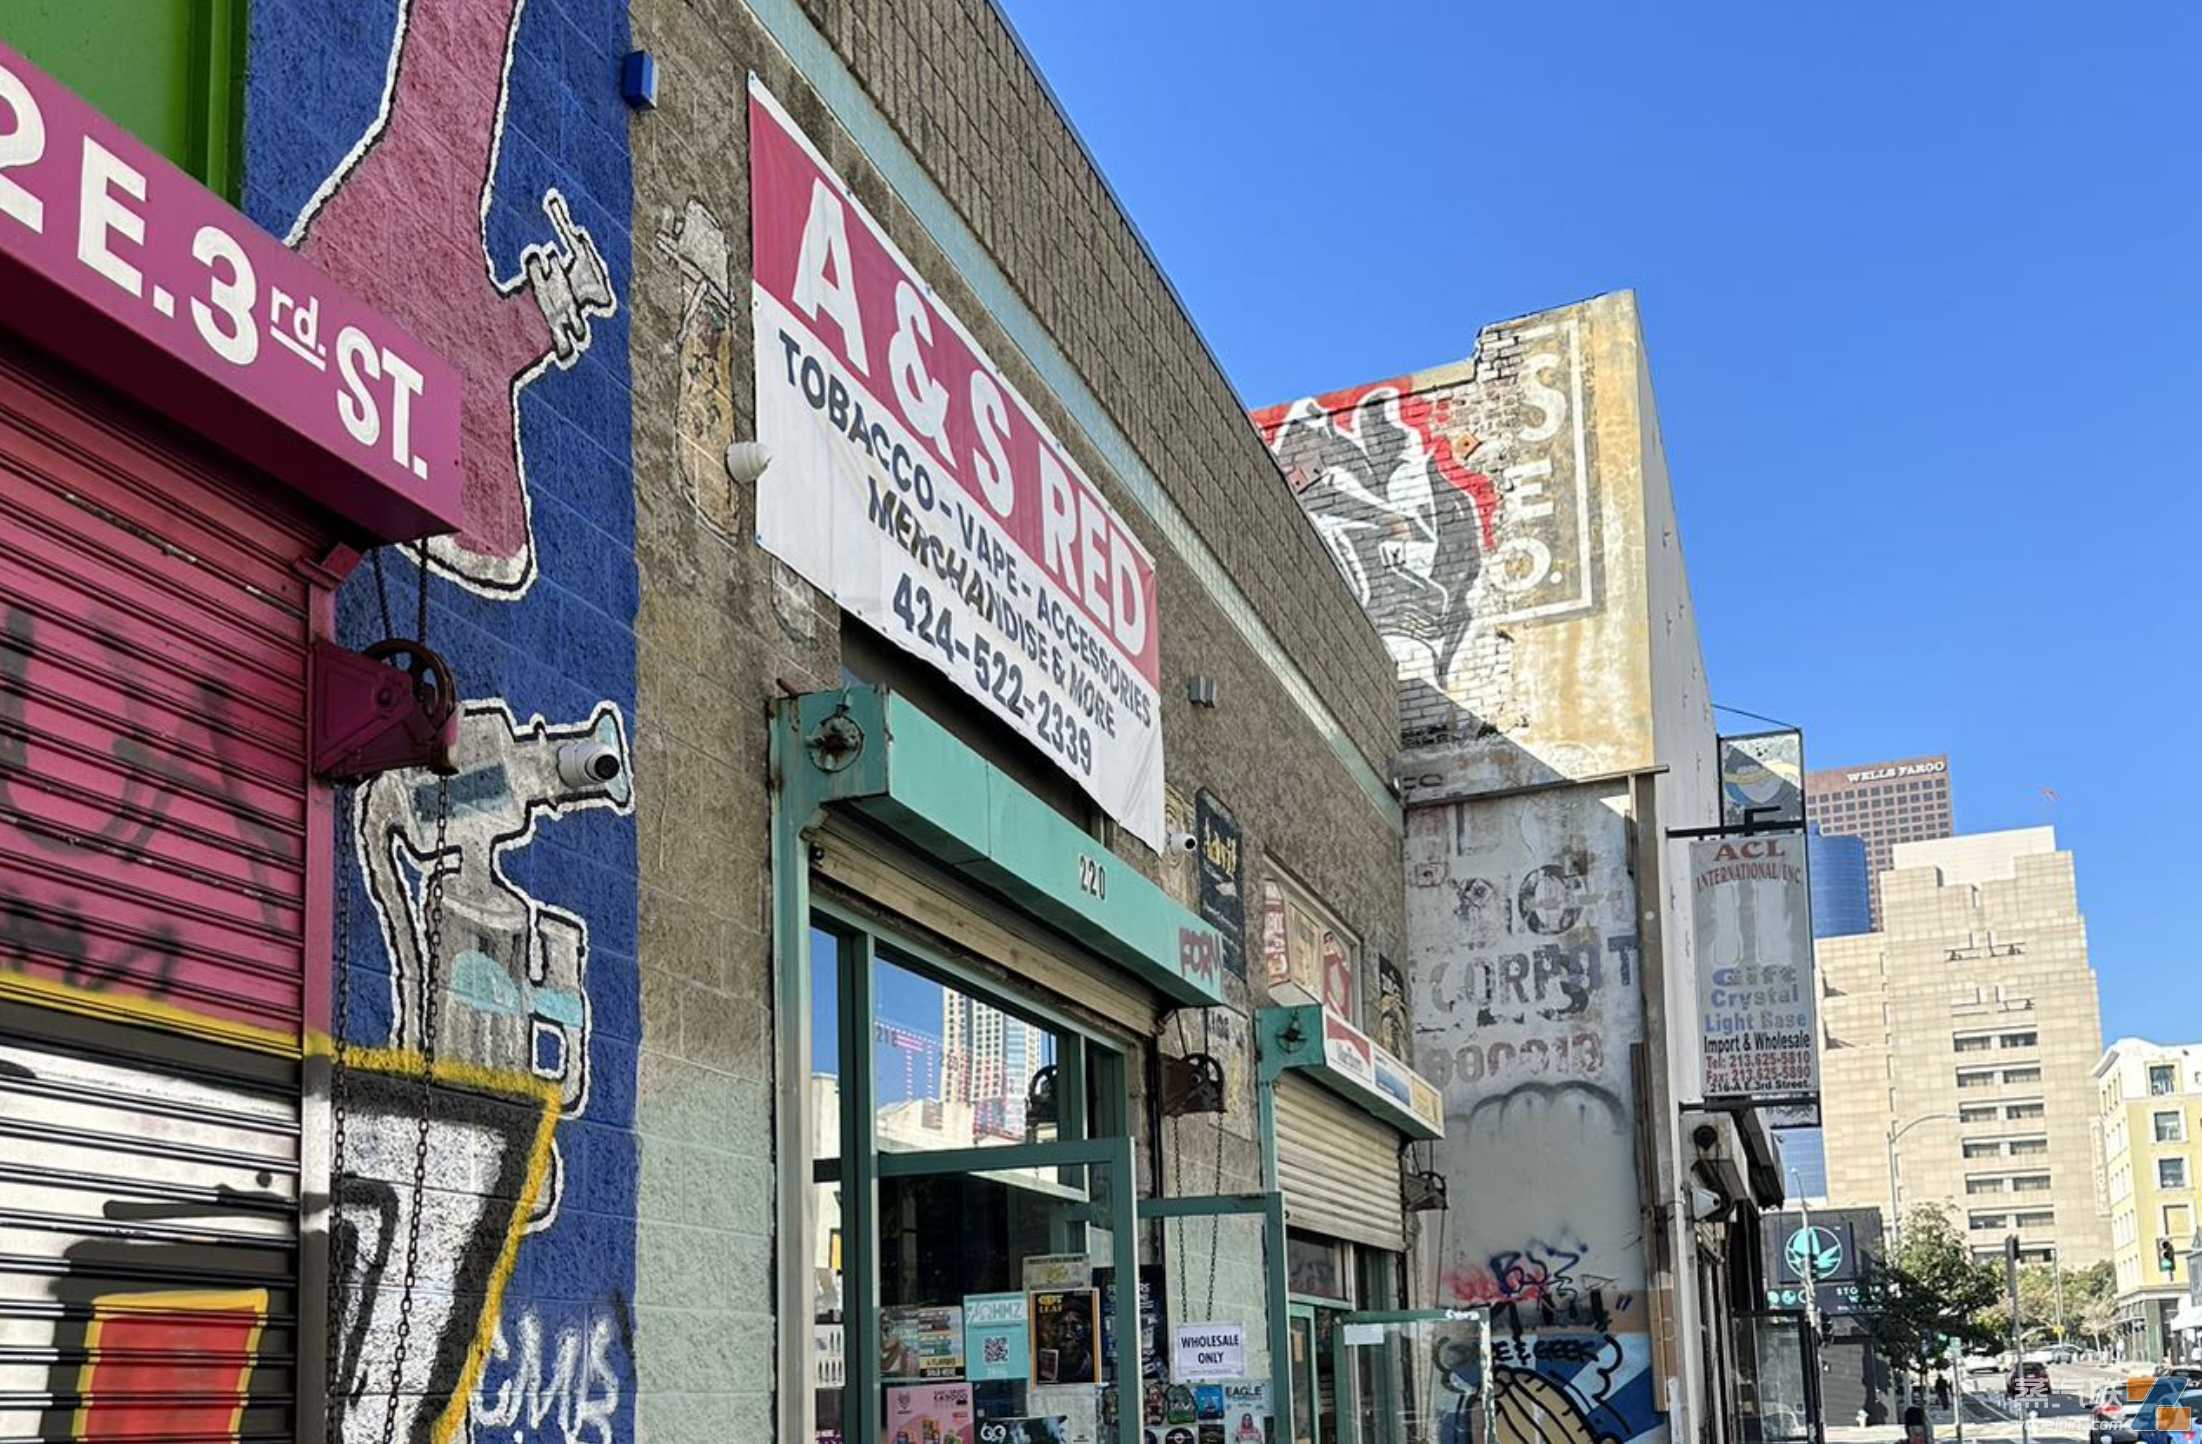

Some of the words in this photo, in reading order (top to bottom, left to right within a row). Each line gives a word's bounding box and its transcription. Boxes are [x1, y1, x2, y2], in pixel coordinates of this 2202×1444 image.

[77, 134, 175, 319] E.
[336, 325, 428, 480] ST.
[793, 177, 870, 377] A
[888, 280, 957, 470] &
[970, 369, 1015, 518] S
[1039, 442, 1146, 657] RED
[779, 330, 935, 511] TOBACCO
[957, 502, 1018, 597] VAPE
[1037, 586, 1151, 728] ACCESSORIES
[867, 477, 1048, 672] MERCHANDISE
[1051, 646, 1066, 688] &
[1069, 662, 1116, 739] MORE
[893, 573, 1092, 777] 424-522-2339
[1847, 768, 1896, 783] WELLS
[1898, 761, 1947, 776] FARGO
[1713, 840, 1786, 861] ACL
[1080, 854, 1106, 901] 220
[1697, 862, 1778, 892] INTERNATIONAL
[1711, 984, 1799, 1010] Crystal
[1704, 1013, 1754, 1035] Light
[1704, 1035, 1740, 1053] Import
[1742, 1033, 1751, 1051] &
[1753, 1030, 1810, 1050] Wholesale
[1706, 1056, 1726, 1069] Tel:
[1706, 1070, 1728, 1083] Fax:
[1181, 1334, 1239, 1348] WHOLESALE
[1198, 1352, 1224, 1364] ONLY
[1225, 1385, 1263, 1398] EAGLE
